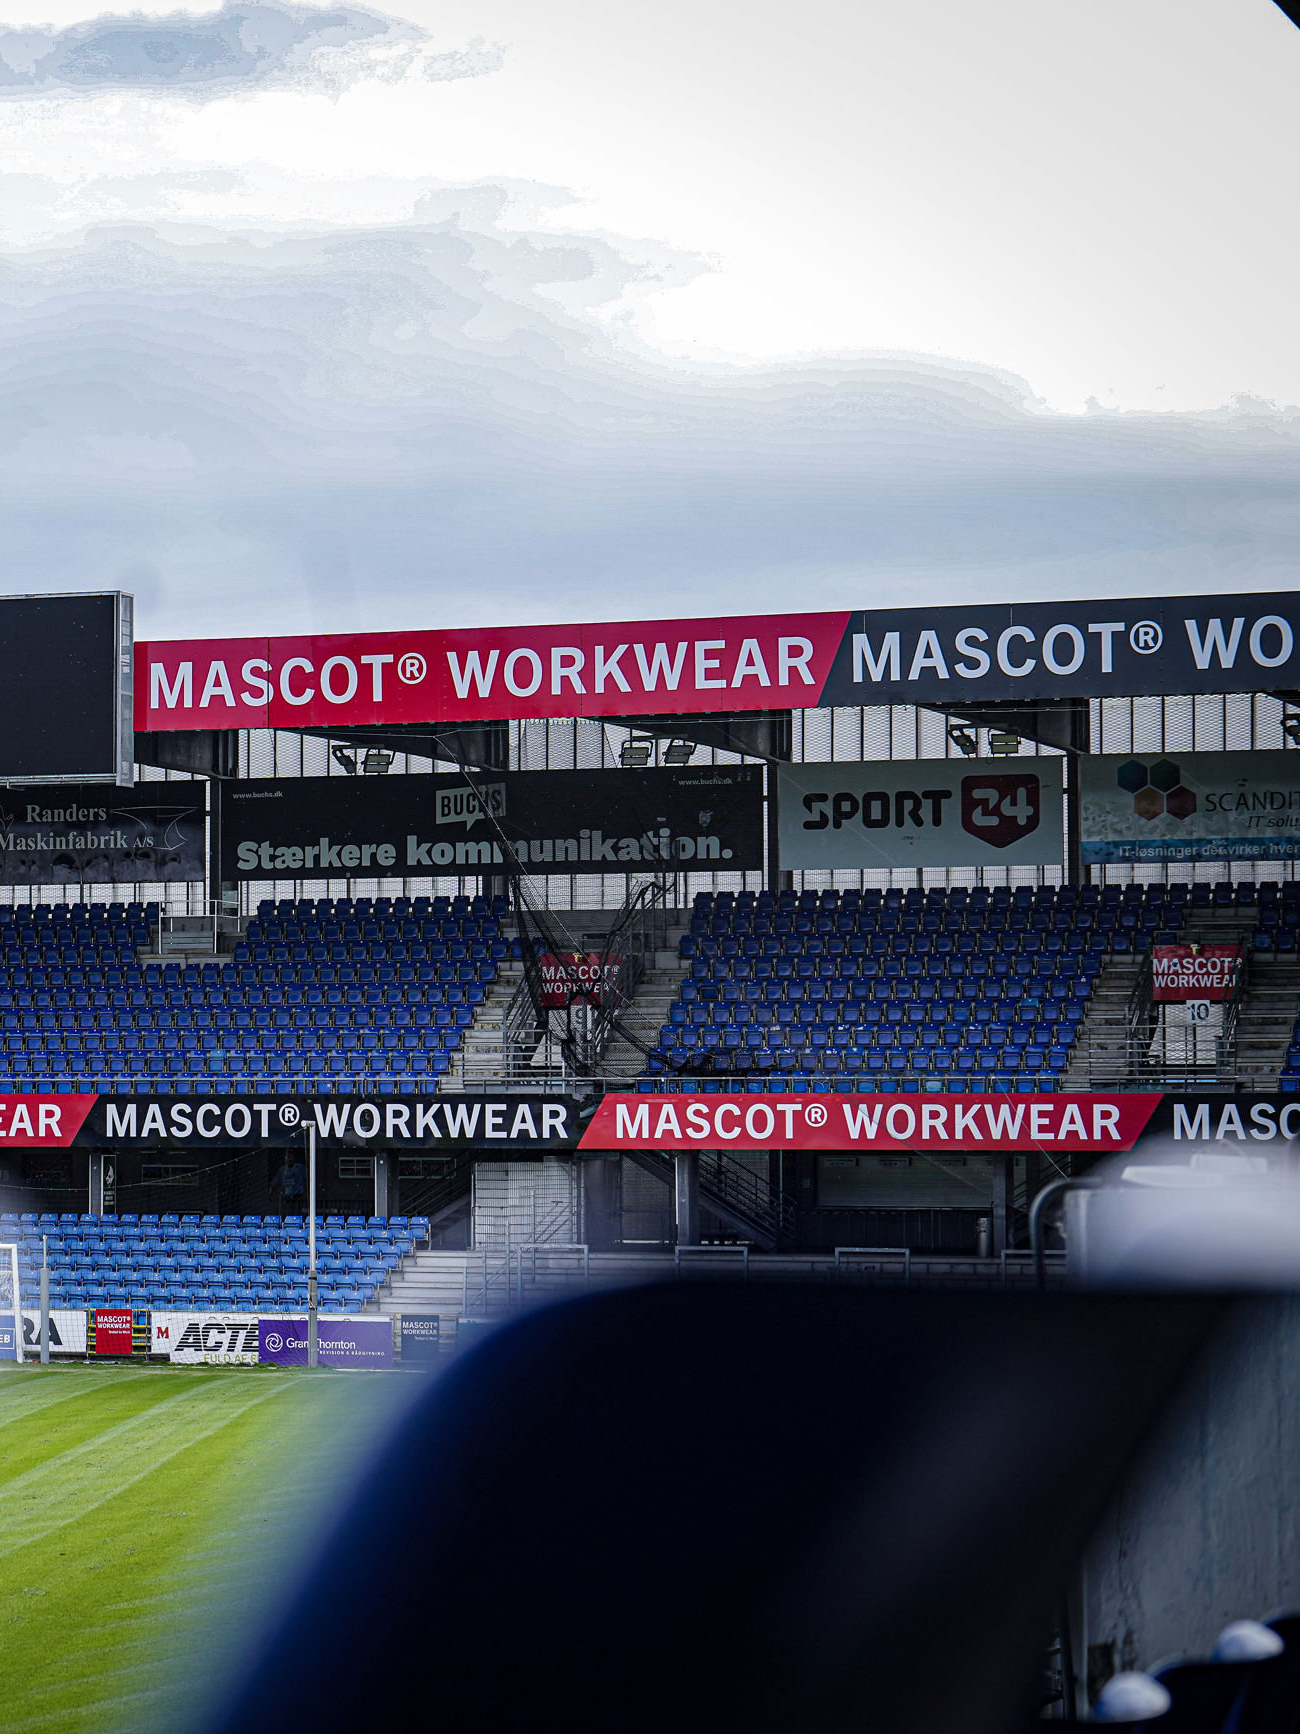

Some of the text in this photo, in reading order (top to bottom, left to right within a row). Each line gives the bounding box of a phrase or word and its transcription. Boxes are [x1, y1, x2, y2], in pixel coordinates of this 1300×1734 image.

[852, 615, 1294, 683] MASCOT® WO
[151, 637, 815, 708] MASCOT® WORKWEAR
[232, 790, 283, 799] www.buchs.dk
[440, 788, 502, 817] BUCHS
[26, 804, 107, 823] Randers
[803, 787, 1034, 830] SPORT 24
[1247, 815, 1265, 828] IT
[133, 836, 154, 848] A/S
[237, 828, 733, 870] Stærkere kommunikation.
[1229, 843, 1266, 855] virker
[1188, 1003, 1209, 1020] 10
[107, 1104, 568, 1138] MASCOT® WORKWEAR
[616, 1103, 1121, 1140] MASCOT® WORKWEAR
[157, 1327, 169, 1339] M
[286, 1337, 308, 1349] Gran
